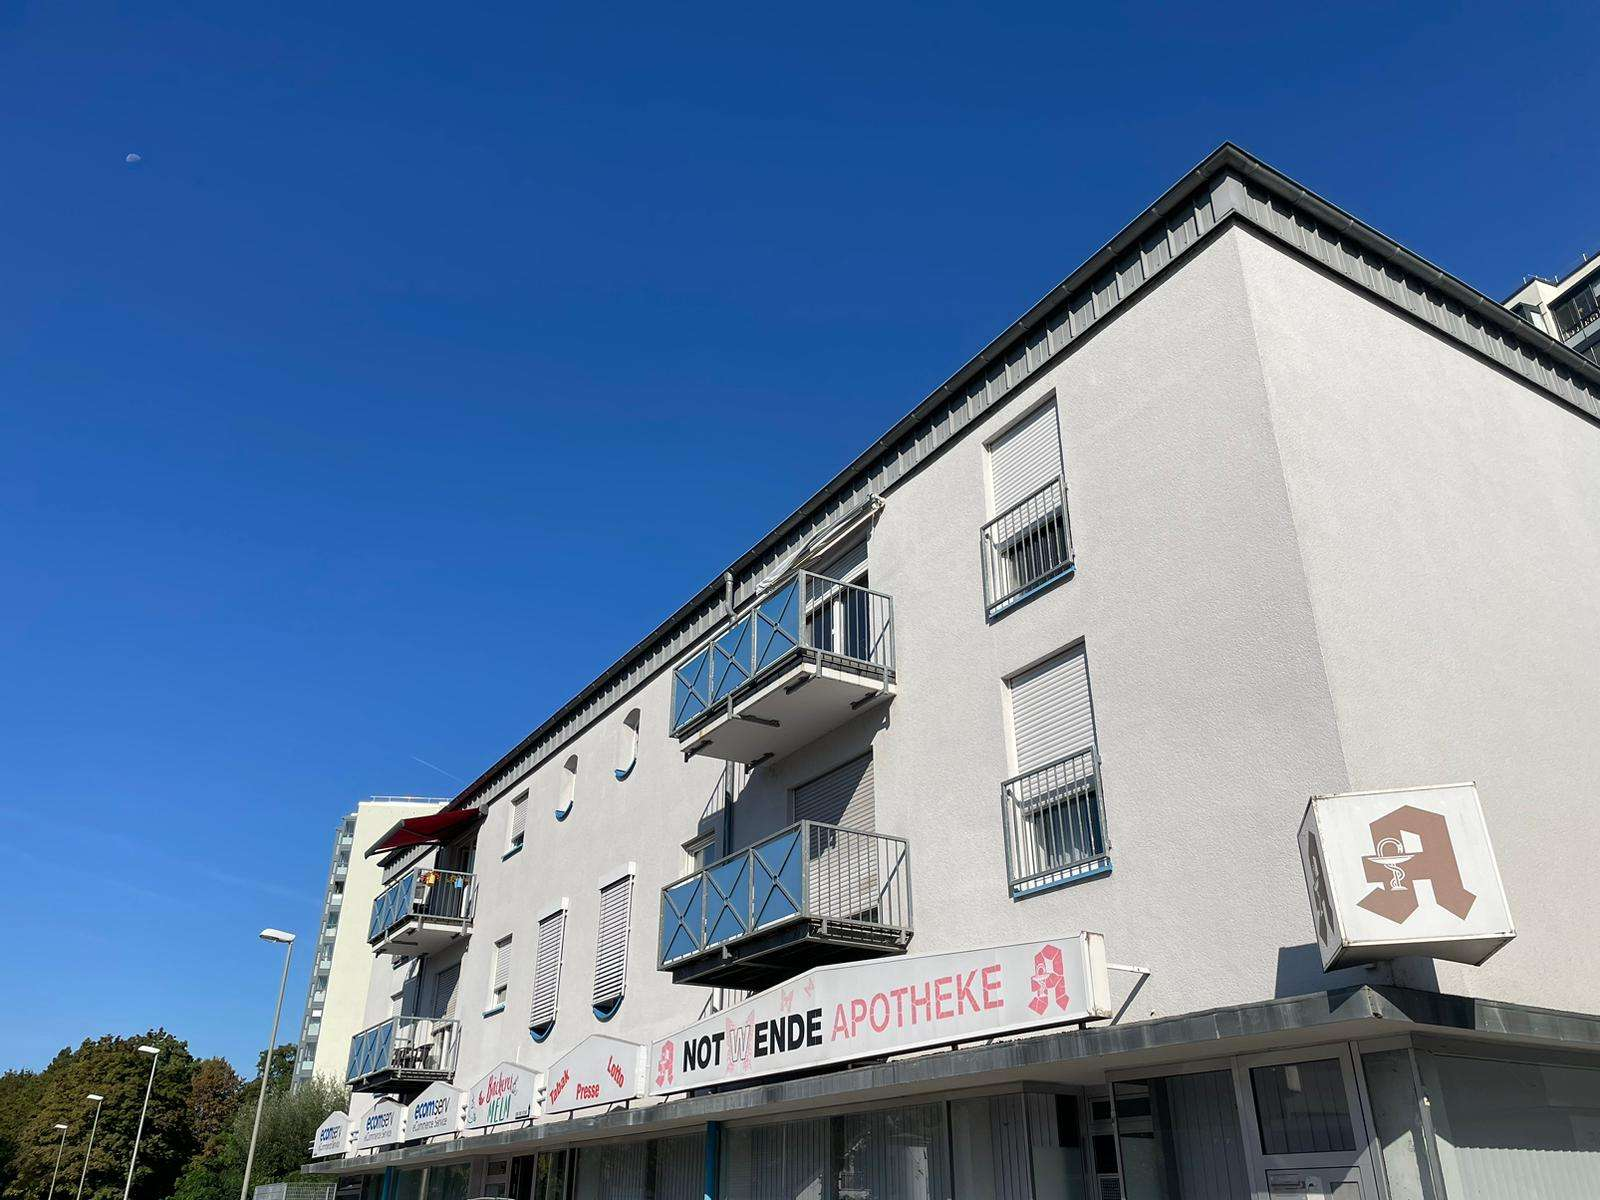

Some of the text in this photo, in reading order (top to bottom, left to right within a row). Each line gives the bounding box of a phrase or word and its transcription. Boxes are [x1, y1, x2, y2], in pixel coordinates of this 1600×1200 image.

[831, 963, 1005, 1042] APOTHEKE
[607, 1055, 625, 1089] Lotto
[576, 1083, 600, 1100] Presse
[415, 1096, 450, 1119] ecomserv
[366, 1112, 393, 1131] ecomserv
[320, 1126, 341, 1141] ecomserv
